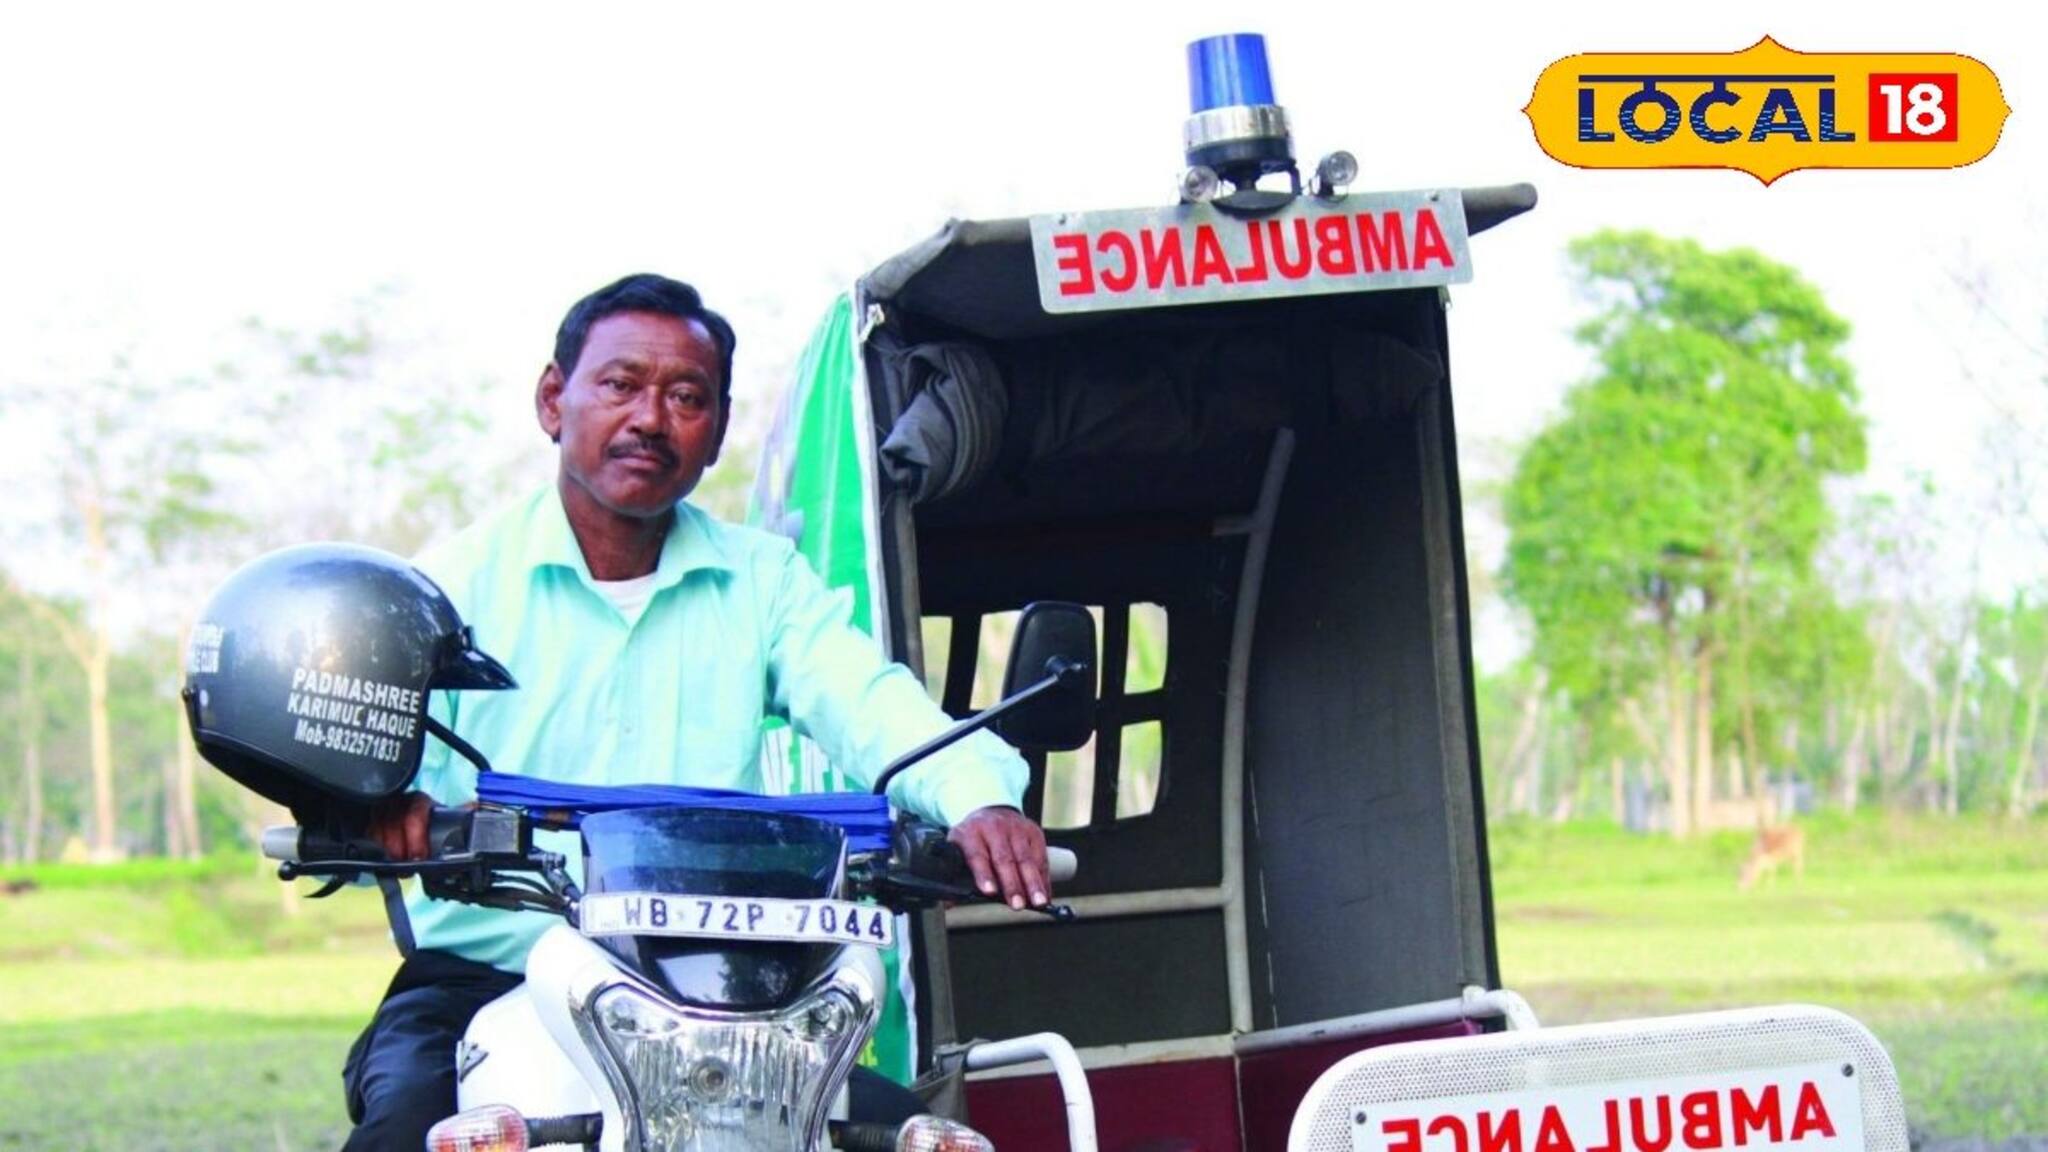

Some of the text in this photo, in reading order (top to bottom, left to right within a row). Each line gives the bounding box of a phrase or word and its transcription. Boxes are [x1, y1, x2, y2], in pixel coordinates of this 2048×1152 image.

[292, 668, 420, 713] PADMASHREE
[366, 708, 417, 739] HAQUE
[625, 897, 885, 940] WB 72P 7044
